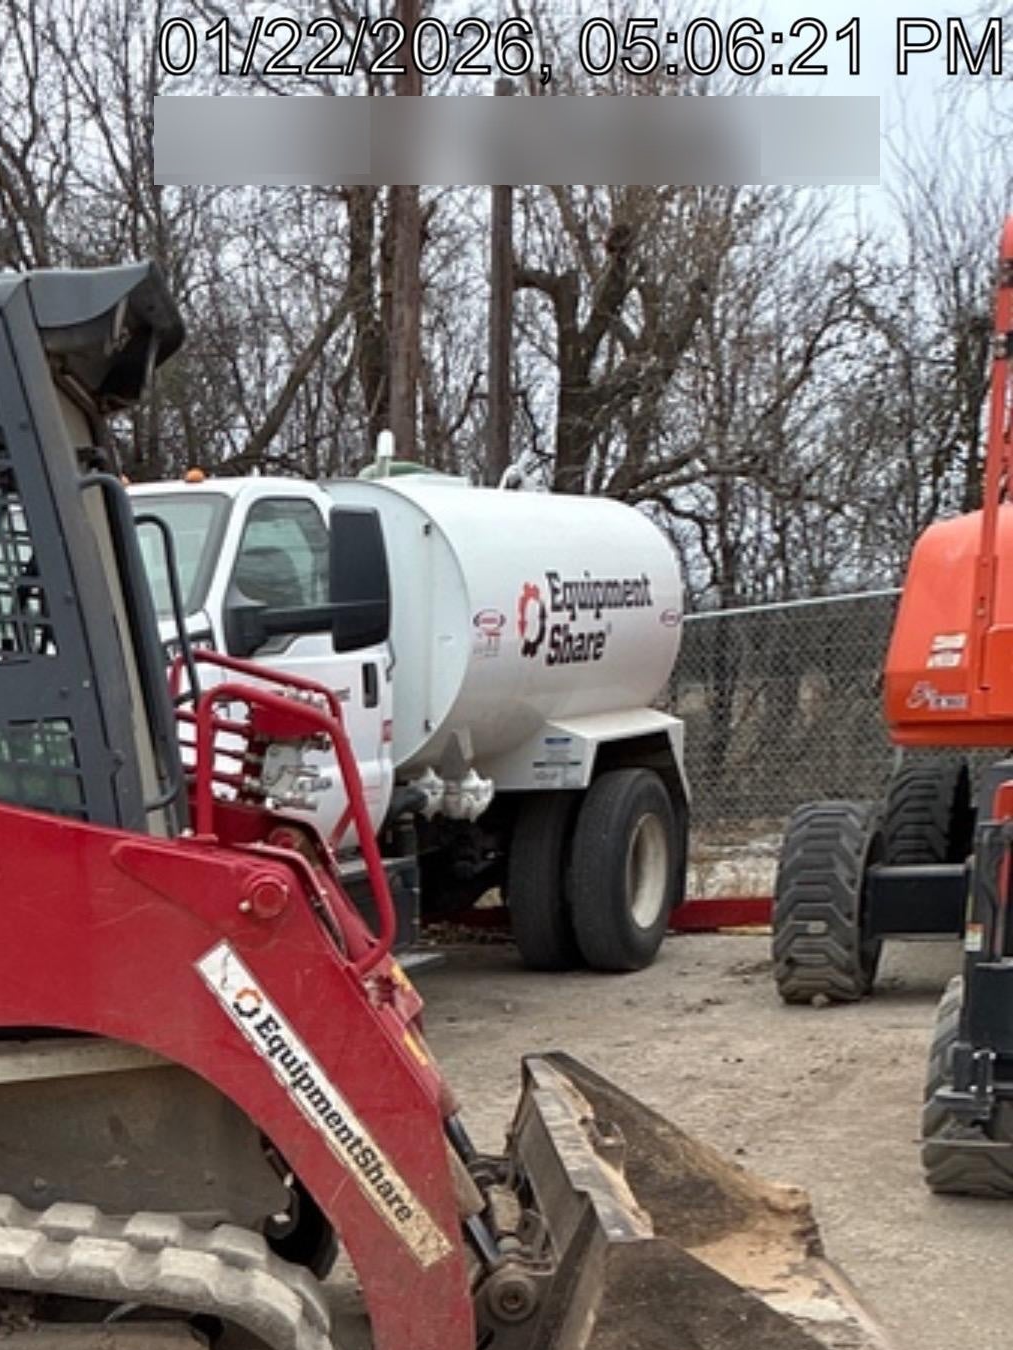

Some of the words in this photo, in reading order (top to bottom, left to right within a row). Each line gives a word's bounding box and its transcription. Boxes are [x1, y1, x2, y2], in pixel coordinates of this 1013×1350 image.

[545, 570, 653, 622] Equipment
[546, 623, 606, 666] Share
[254, 1013, 414, 1223] EquipmentShare
